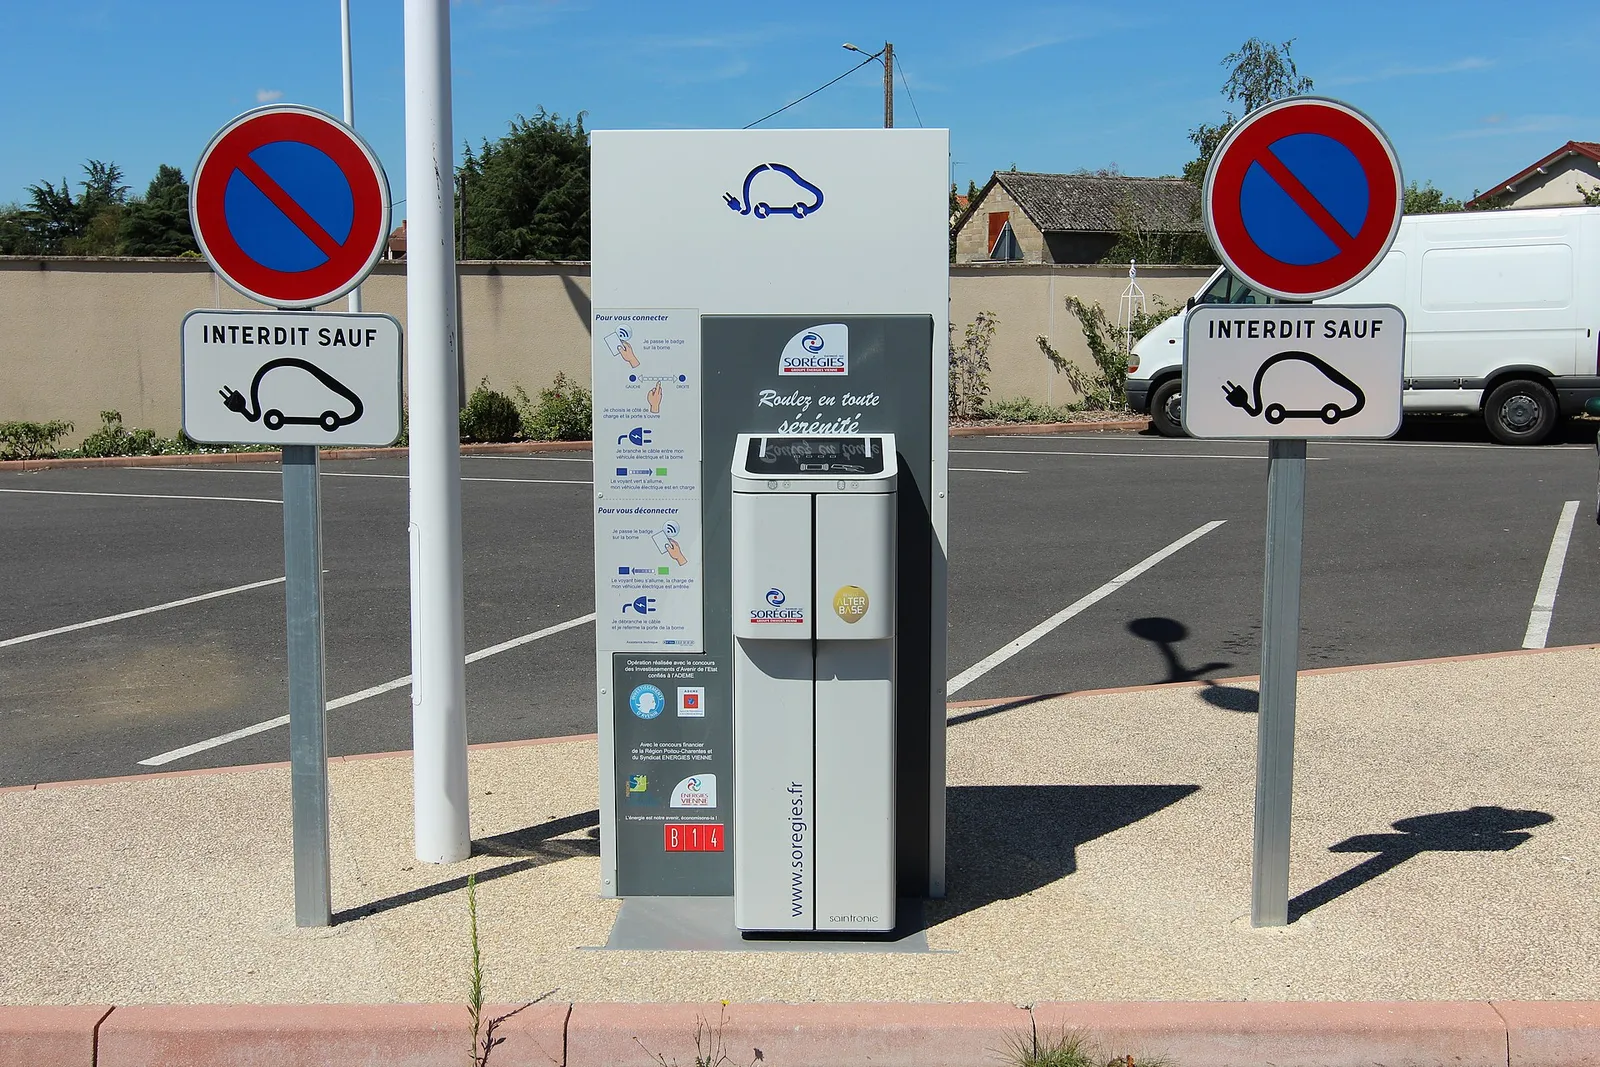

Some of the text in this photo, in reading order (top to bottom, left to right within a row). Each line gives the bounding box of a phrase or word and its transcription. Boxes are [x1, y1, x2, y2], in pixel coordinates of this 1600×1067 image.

[203, 325, 377, 347] INTERDIT SAUF
[1209, 320, 1383, 339] INTERDIT SAUF
[784, 356, 844, 367] SORÉGIES
[758, 389, 880, 411] Roulez en toute
[778, 413, 862, 434] sérénité
[836, 597, 866, 606] ALTER
[839, 606, 863, 614] BASE
[751, 609, 803, 618] SORÉGIES
[671, 828, 717, 848] B14
[786, 781, 808, 917] www.soregies.fr
[829, 914, 879, 923] saintronic
